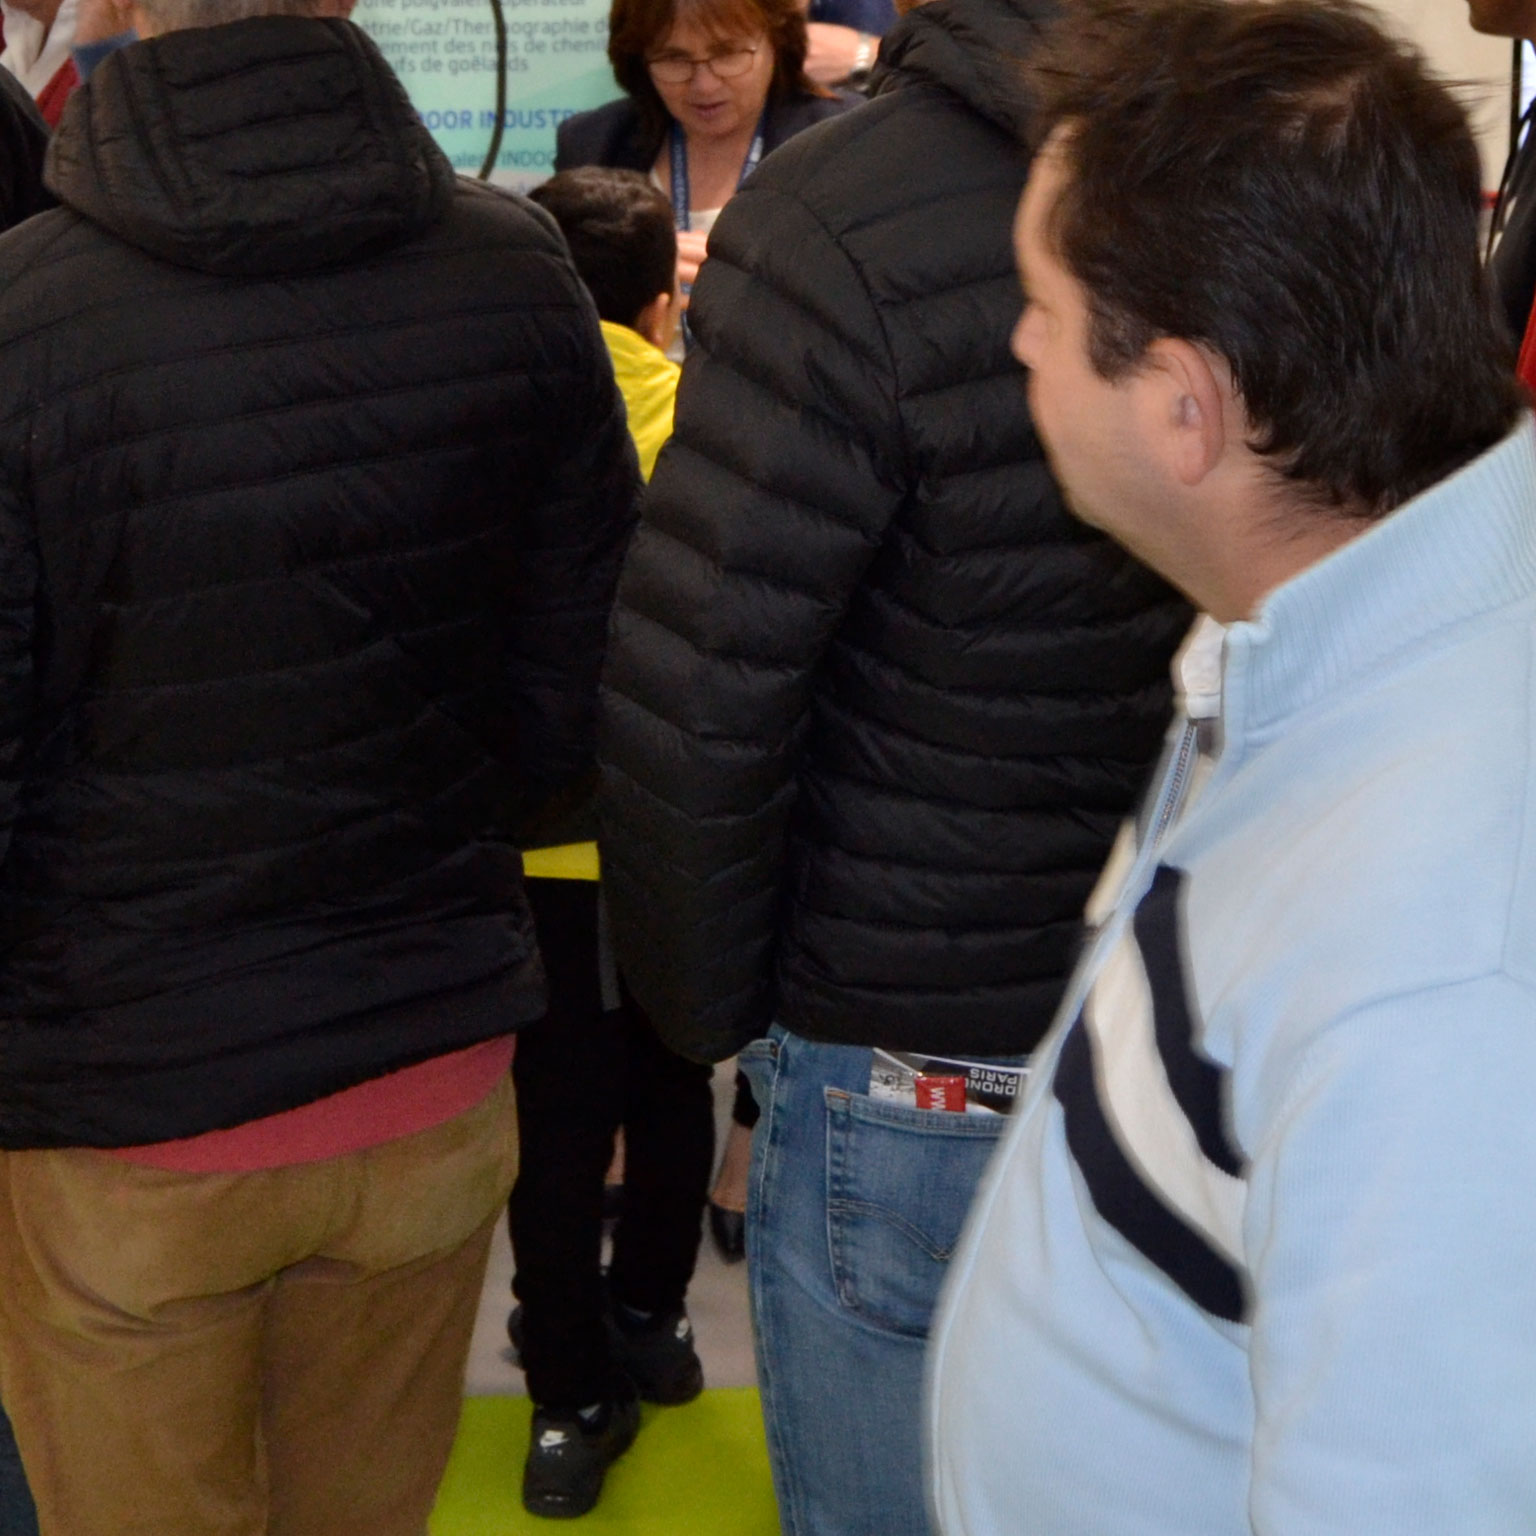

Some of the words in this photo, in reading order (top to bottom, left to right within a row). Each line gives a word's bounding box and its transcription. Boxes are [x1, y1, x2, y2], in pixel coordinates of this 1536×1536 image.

[444, 38, 476, 54] des
[524, 38, 547, 54] de
[421, 56, 442, 72] de
[969, 1067, 1018, 1085] PARIS
